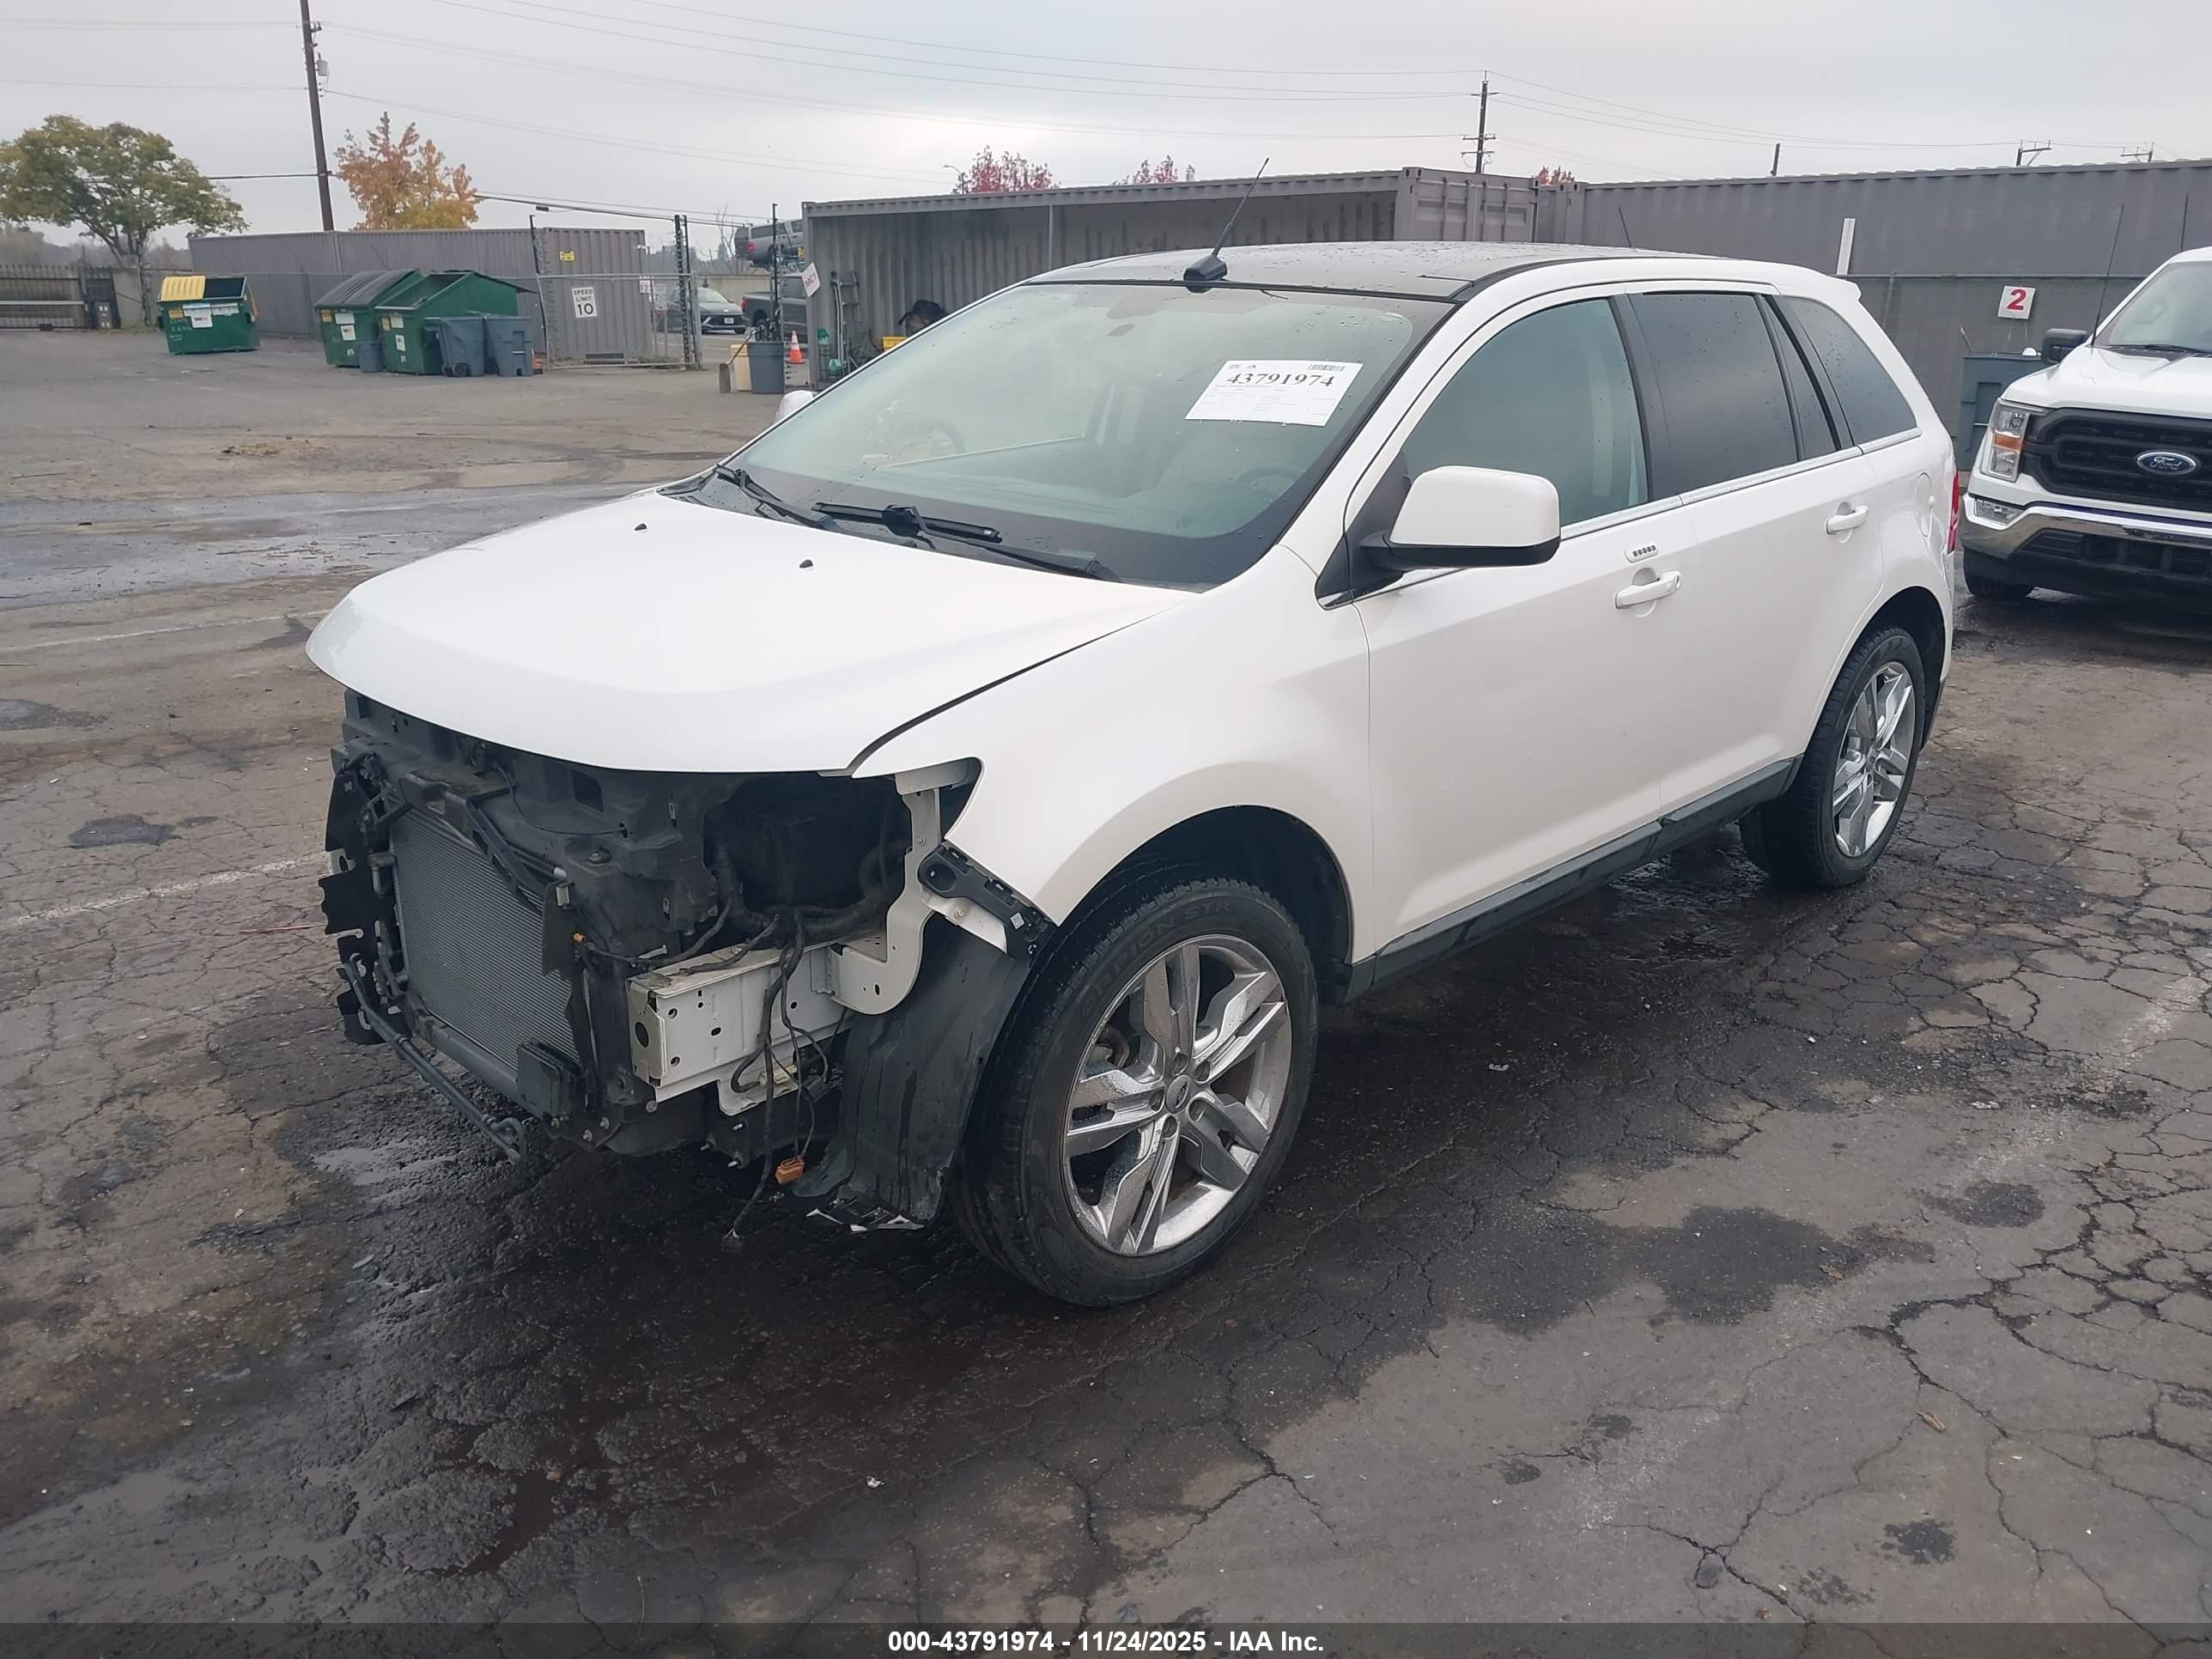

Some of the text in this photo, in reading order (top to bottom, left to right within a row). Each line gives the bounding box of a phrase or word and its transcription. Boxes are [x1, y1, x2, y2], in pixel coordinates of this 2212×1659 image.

[2006, 289, 2027, 311] 2
[577, 303, 594, 315] 10
[1226, 373, 1335, 387] 43791974
[2149, 456, 2183, 471] Ford
